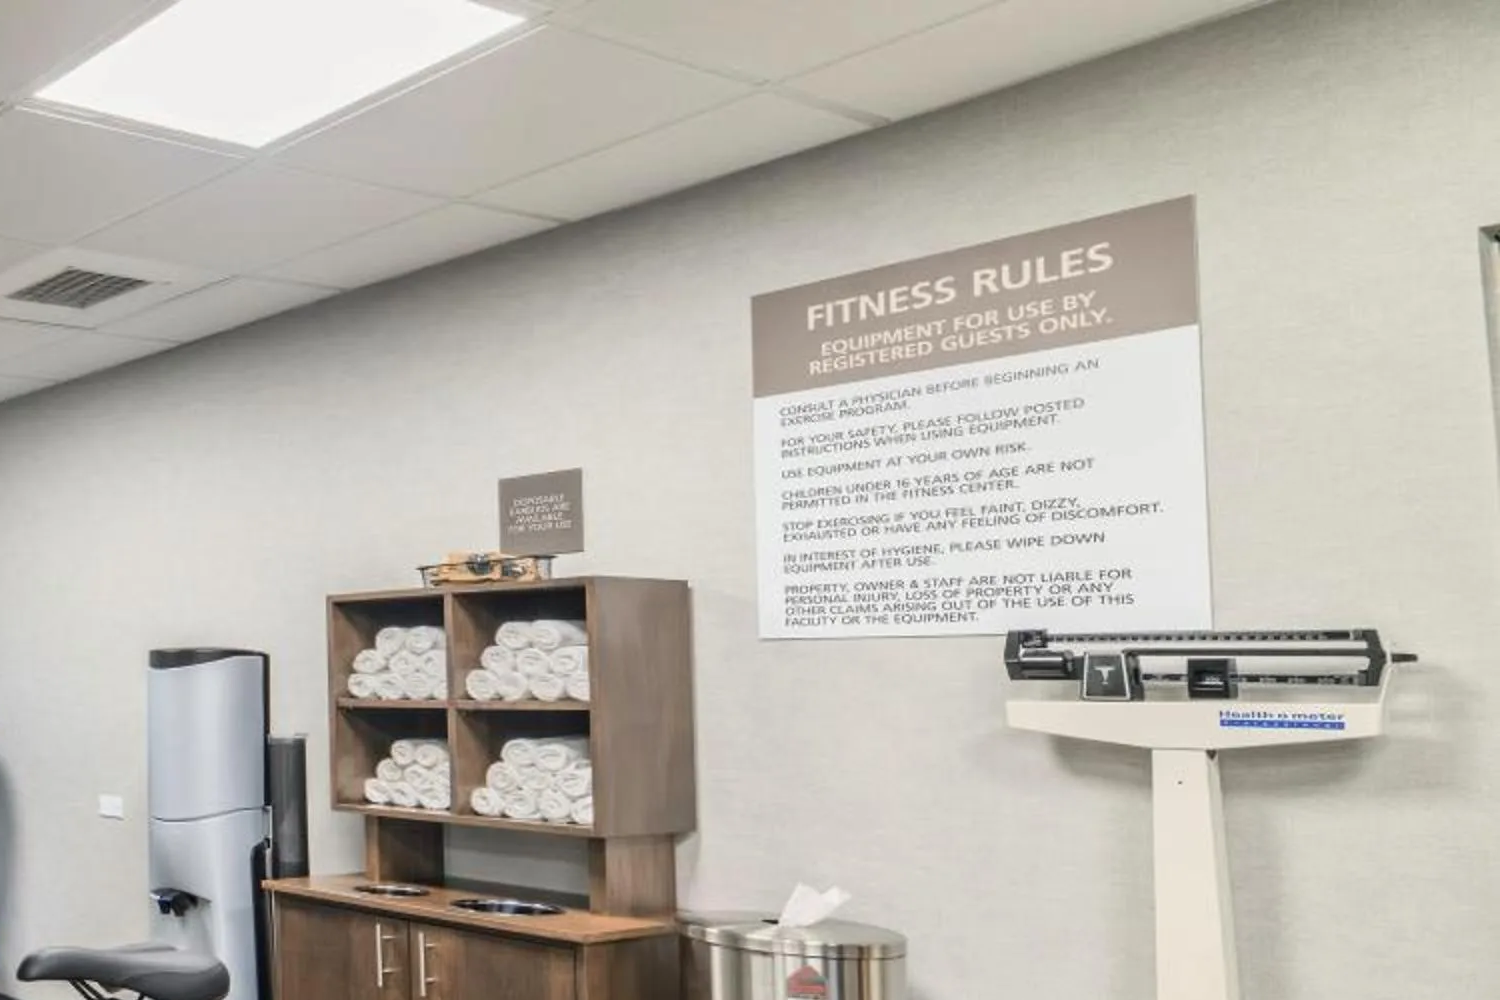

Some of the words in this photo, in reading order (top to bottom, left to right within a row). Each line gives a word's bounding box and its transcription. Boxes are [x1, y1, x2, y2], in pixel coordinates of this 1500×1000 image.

[806, 275, 957, 330] FITNESS
[971, 241, 1114, 296] RULES
[820, 320, 946, 356] EQUIPMENT
[952, 310, 999, 331] FOR
[1007, 299, 1054, 321] USE
[1062, 291, 1097, 311] BY
[808, 341, 933, 375] REGISTERED
[940, 323, 1031, 352] GUESTS
[1038, 307, 1113, 335] ONLY.
[837, 399, 848, 408] A
[851, 387, 921, 406] PHYSICIAN
[925, 378, 979, 395] BEFORE
[983, 364, 1068, 386] BEGINNING
[1073, 359, 1100, 372] AN
[780, 437, 804, 449] FOR
[809, 432, 844, 445] YOUR
[902, 417, 952, 432] PLEASE
[956, 407, 1018, 425] FOLLOW
[1022, 398, 1085, 416] POSTED
[780, 439, 870, 459] INSTRUCTIONS
[873, 433, 917, 447] WHEN
[920, 427, 963, 441] USING
[780, 469, 802, 480] USE
[806, 460, 881, 477] EQUIPMENT
[884, 457, 902, 468] AT
[906, 452, 947, 465] YOUR
[951, 446, 990, 460] OWN
[780, 486, 843, 500] CHILDREN
[845, 481, 891, 494] UNDER
[895, 479, 909, 488] 16
[914, 473, 959, 486] YEARS
[962, 471, 983, 481] OF
[988, 467, 1018, 479] AGE
[1024, 463, 1055, 475] ARE
[1059, 459, 1095, 471] NOT
[781, 497, 851, 511] PERMITTED
[854, 495, 869, 504] IN
[874, 492, 897, 502] THE
[902, 486, 954, 499] FITNESS
[782, 520, 813, 532] STOP
[816, 513, 890, 529] EXERCISING
[893, 512, 905, 523] IF
[909, 509, 941, 521] YOU
[944, 506, 976, 518] FEEL
[782, 527, 857, 542] EXHAUSTED
[860, 526, 880, 536] OR
[884, 522, 920, 534] HAVE
[925, 519, 957, 531] ANY
[960, 514, 1020, 529] FEELING
[1024, 512, 1046, 524] OF
[783, 554, 797, 563] IN
[799, 549, 856, 562] INTEREST
[858, 548, 877, 558] OF
[949, 539, 1000, 553] PLEASE
[1005, 536, 1045, 549] WIPE
[1049, 532, 1105, 546] DOWN
[783, 560, 856, 574] EQUIPMENT
[860, 557, 903, 570] AFTER
[852, 580, 905, 592] OWNER
[922, 577, 964, 588] STAFF
[968, 575, 997, 586] ARE
[1002, 573, 1035, 585] NOT
[1039, 570, 1093, 583] LIABLE
[1098, 568, 1132, 580] FOR
[784, 594, 848, 606] PERSONAL
[904, 590, 937, 601] LOSS
[940, 589, 960, 600] OF
[965, 585, 1043, 599] PROPERTY
[1047, 584, 1071, 595] OR
[1076, 582, 1114, 594] ANY
[785, 606, 827, 616] OTHER
[829, 604, 879, 615] CLAIMS
[882, 601, 937, 613] ARISING
[940, 600, 972, 611] OUT
[976, 599, 997, 610] OF
[1002, 598, 1032, 609] THE
[1036, 596, 1065, 608] USE
[1070, 595, 1093, 607] OF
[1098, 594, 1135, 606] THIS
[784, 616, 837, 627] FACILITY
[840, 615, 861, 625] OR
[864, 614, 889, 625] THE
